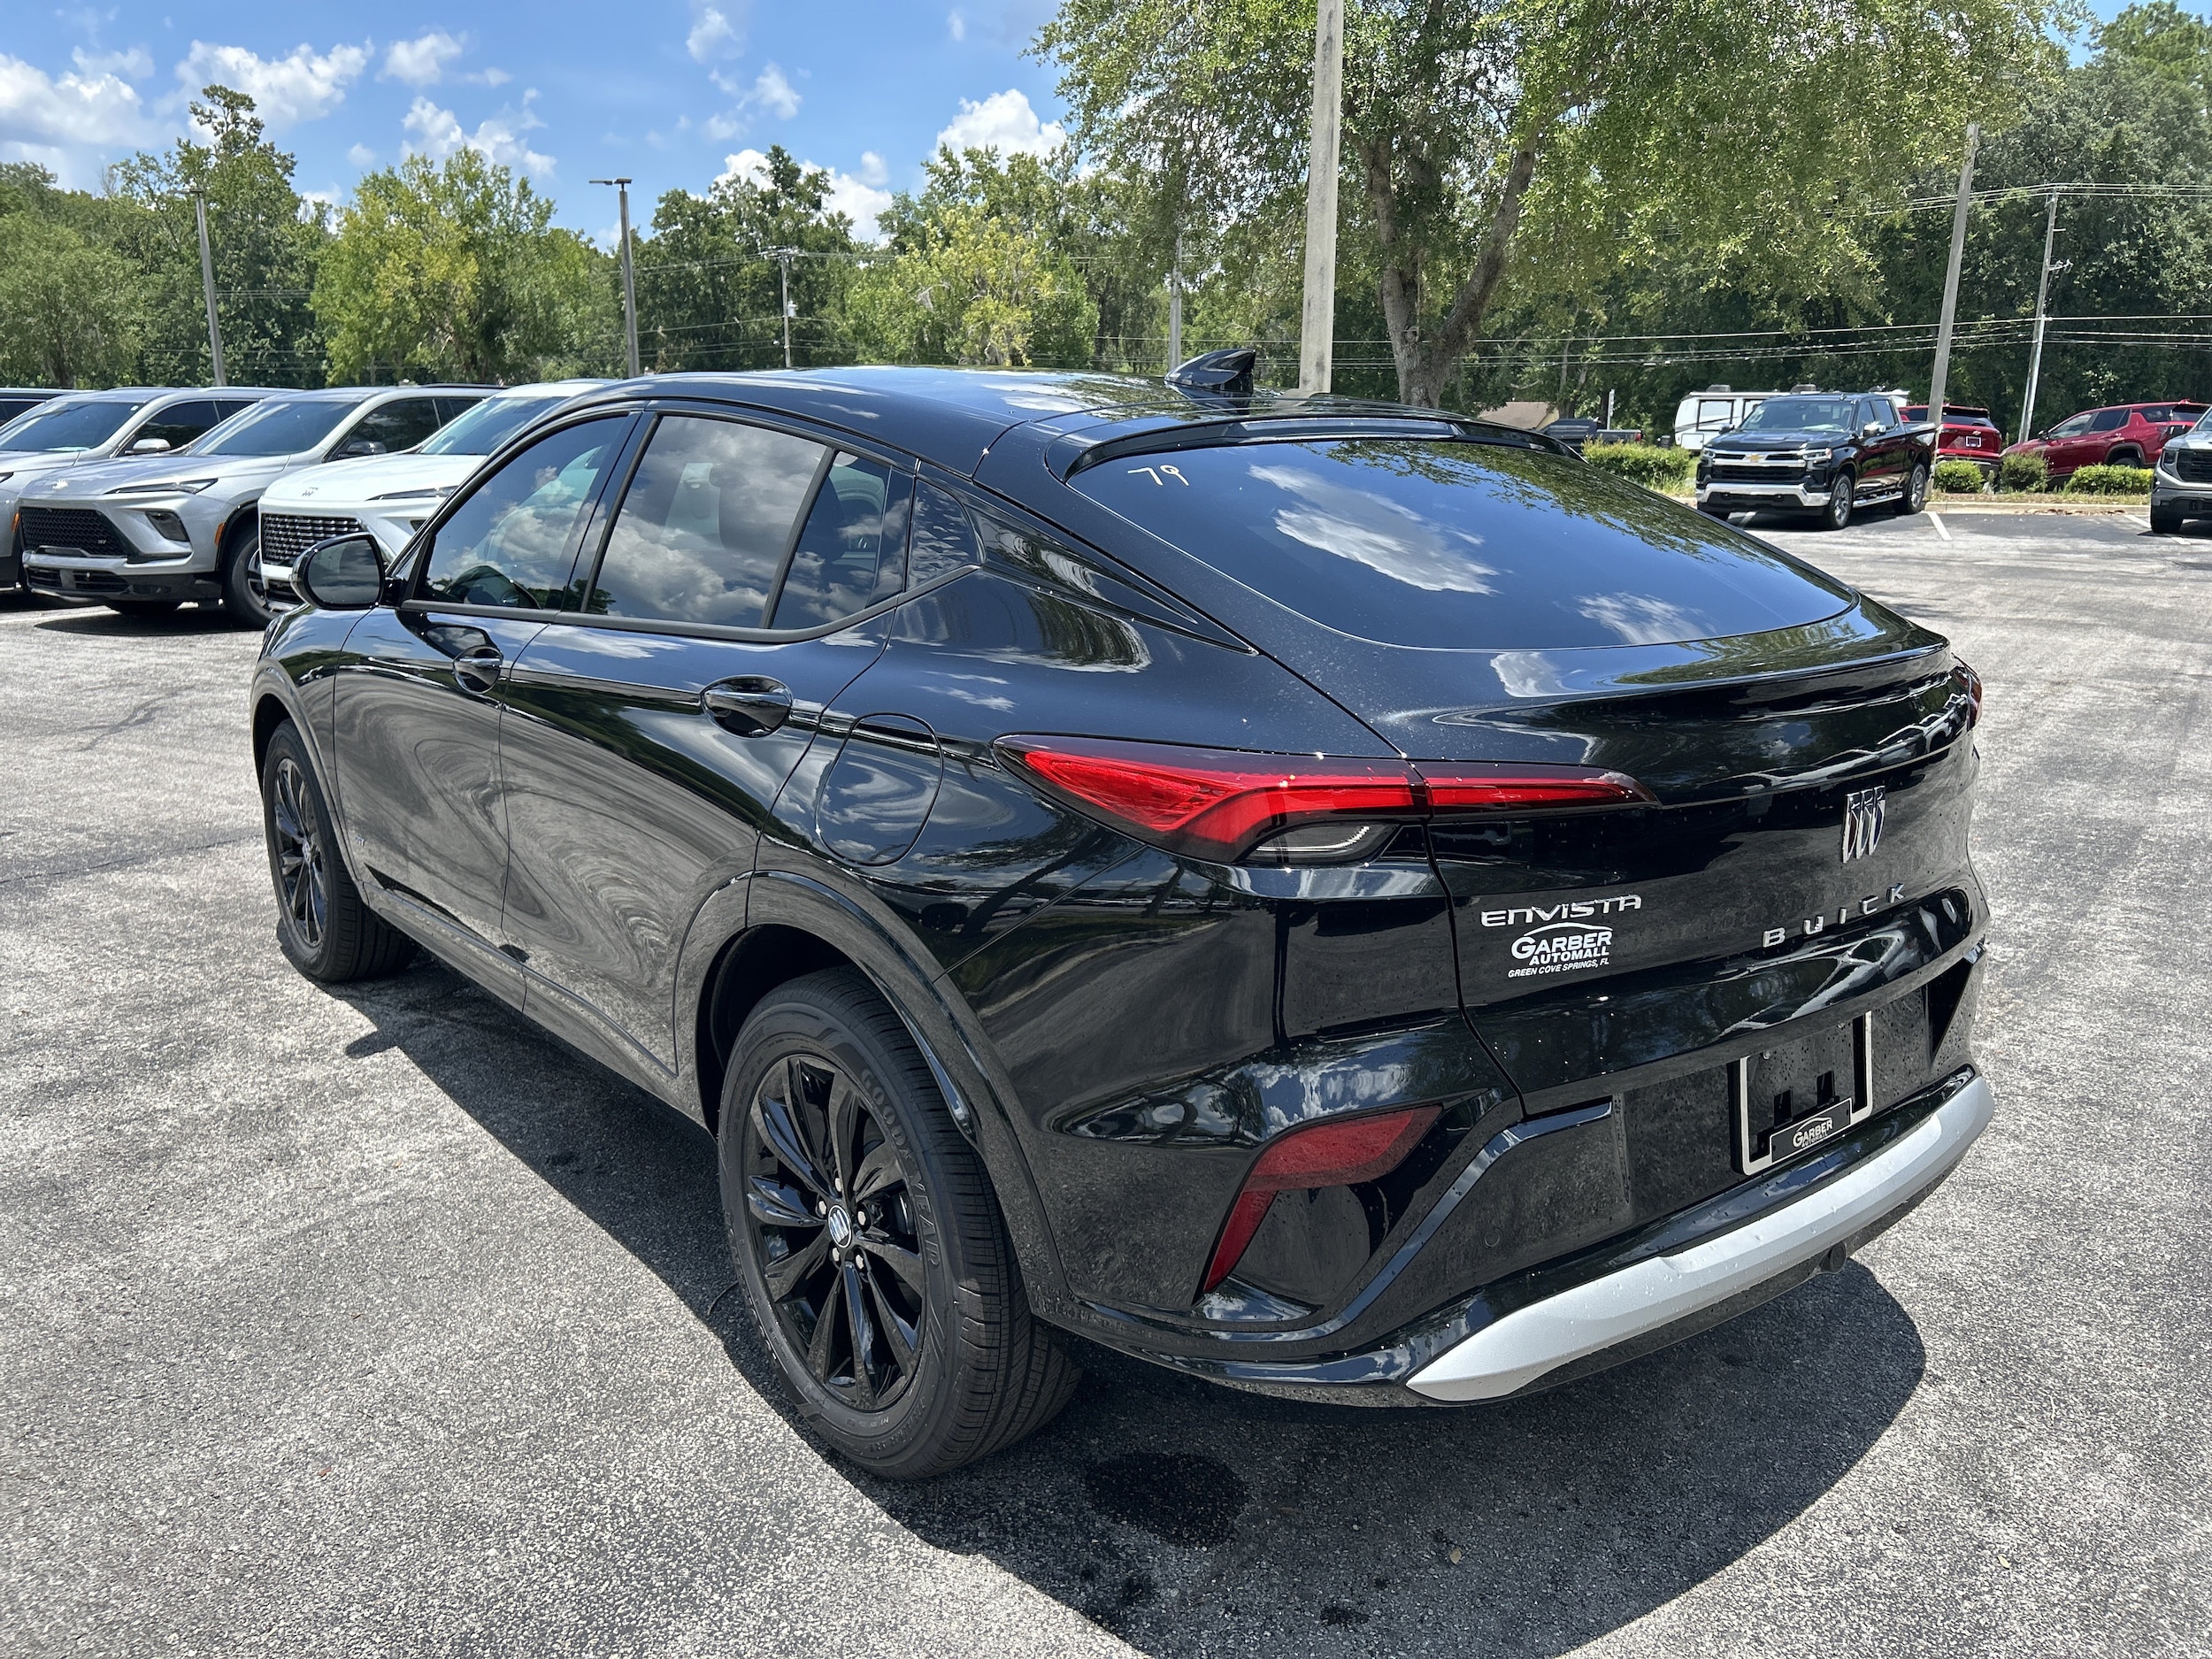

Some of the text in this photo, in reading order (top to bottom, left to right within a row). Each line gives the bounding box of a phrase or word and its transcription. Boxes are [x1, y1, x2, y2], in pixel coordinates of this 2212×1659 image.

[1127, 465, 1189, 487] 79
[1480, 895, 1642, 927] ENVISTA
[1762, 883, 1905, 948] BUICK
[1510, 931, 1613, 959] GARBER
[1529, 945, 1610, 966] AUTOMALL
[1508, 957, 1610, 979] GREEN COVE SPRINGS, FL
[1793, 1119, 1833, 1148] GARBER
